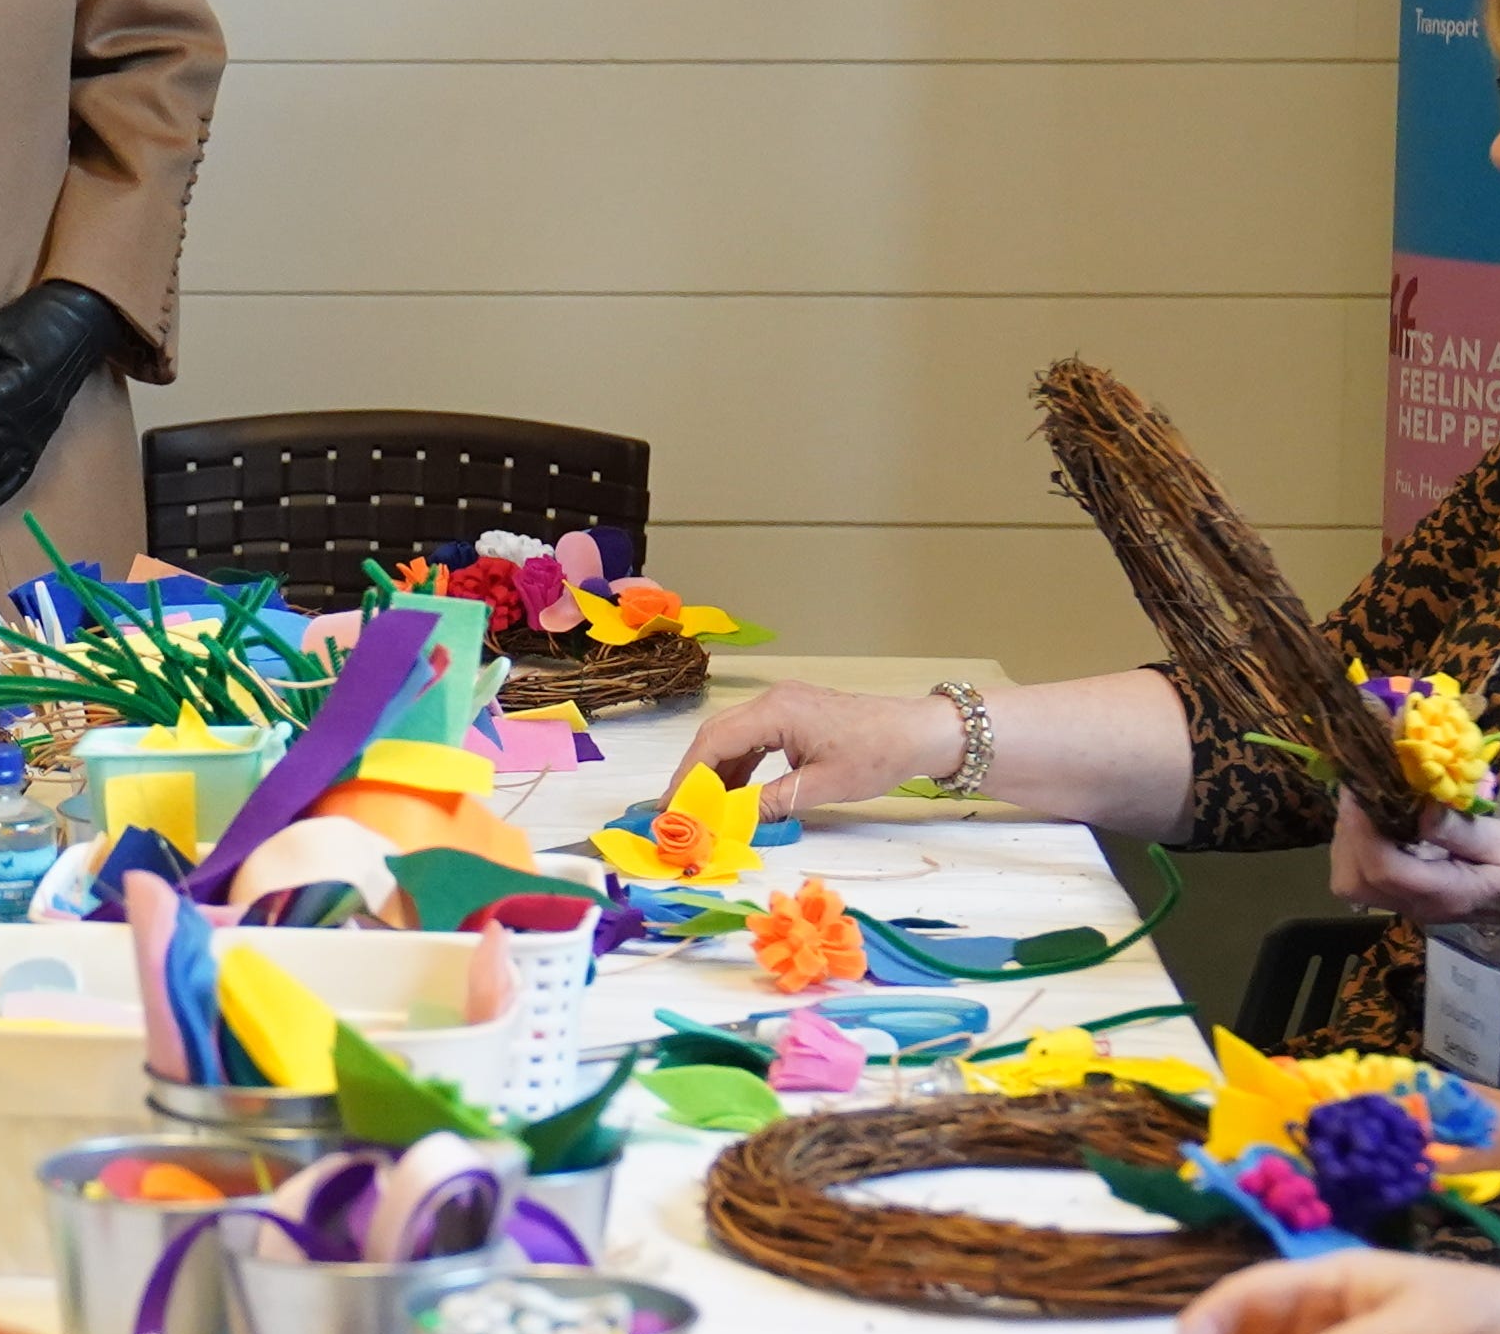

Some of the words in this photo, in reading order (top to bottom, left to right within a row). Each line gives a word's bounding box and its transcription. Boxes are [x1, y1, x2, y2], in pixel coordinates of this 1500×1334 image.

[1415, 7, 1479, 45] Transport
[1401, 328, 1434, 366] IT'S
[1438, 334, 1481, 373] AN
[1398, 404, 1457, 444] HELP
